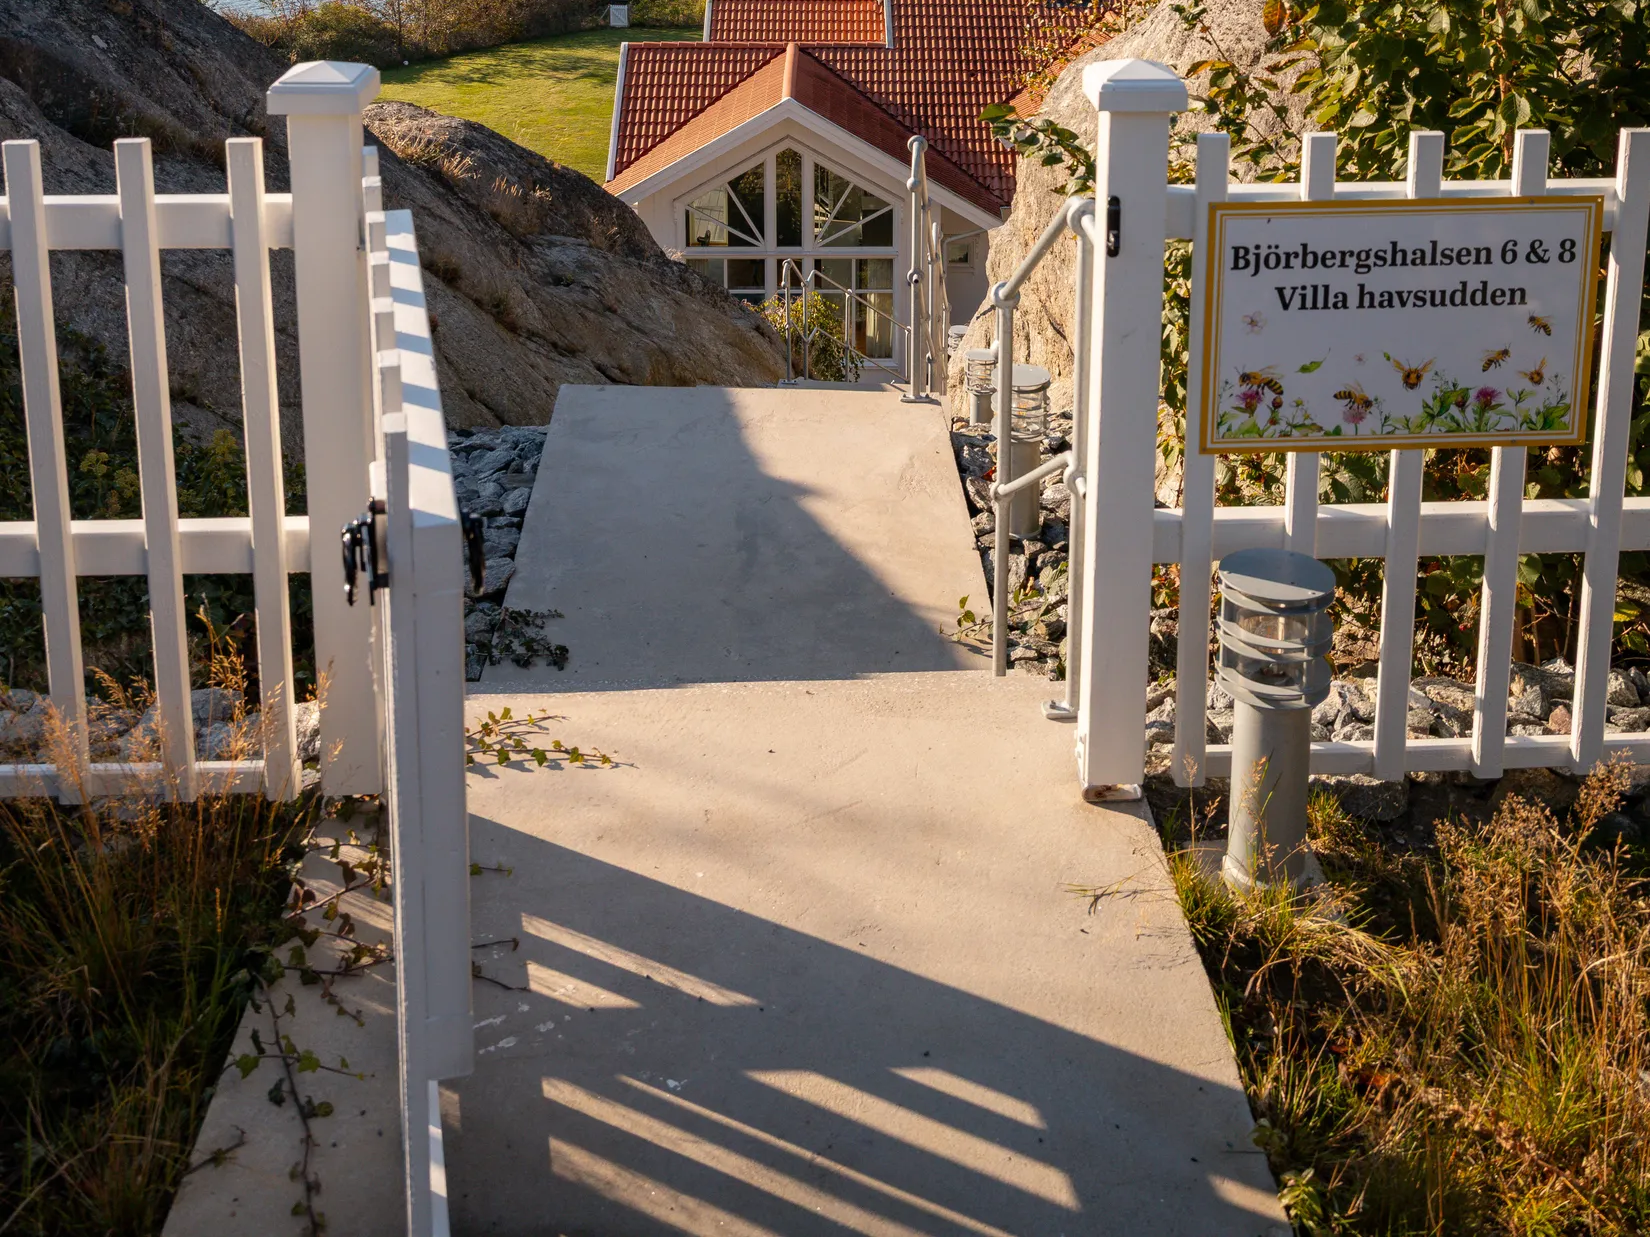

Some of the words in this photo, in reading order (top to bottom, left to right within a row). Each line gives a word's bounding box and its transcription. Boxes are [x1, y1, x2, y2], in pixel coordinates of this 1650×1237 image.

[1230, 240, 1493, 277] Björbergshalsen
[1500, 239, 1519, 264] 6
[1525, 238, 1551, 263] &
[1558, 238, 1577, 263] 8
[1274, 284, 1350, 311] Villa
[1356, 280, 1528, 309] havsudden
